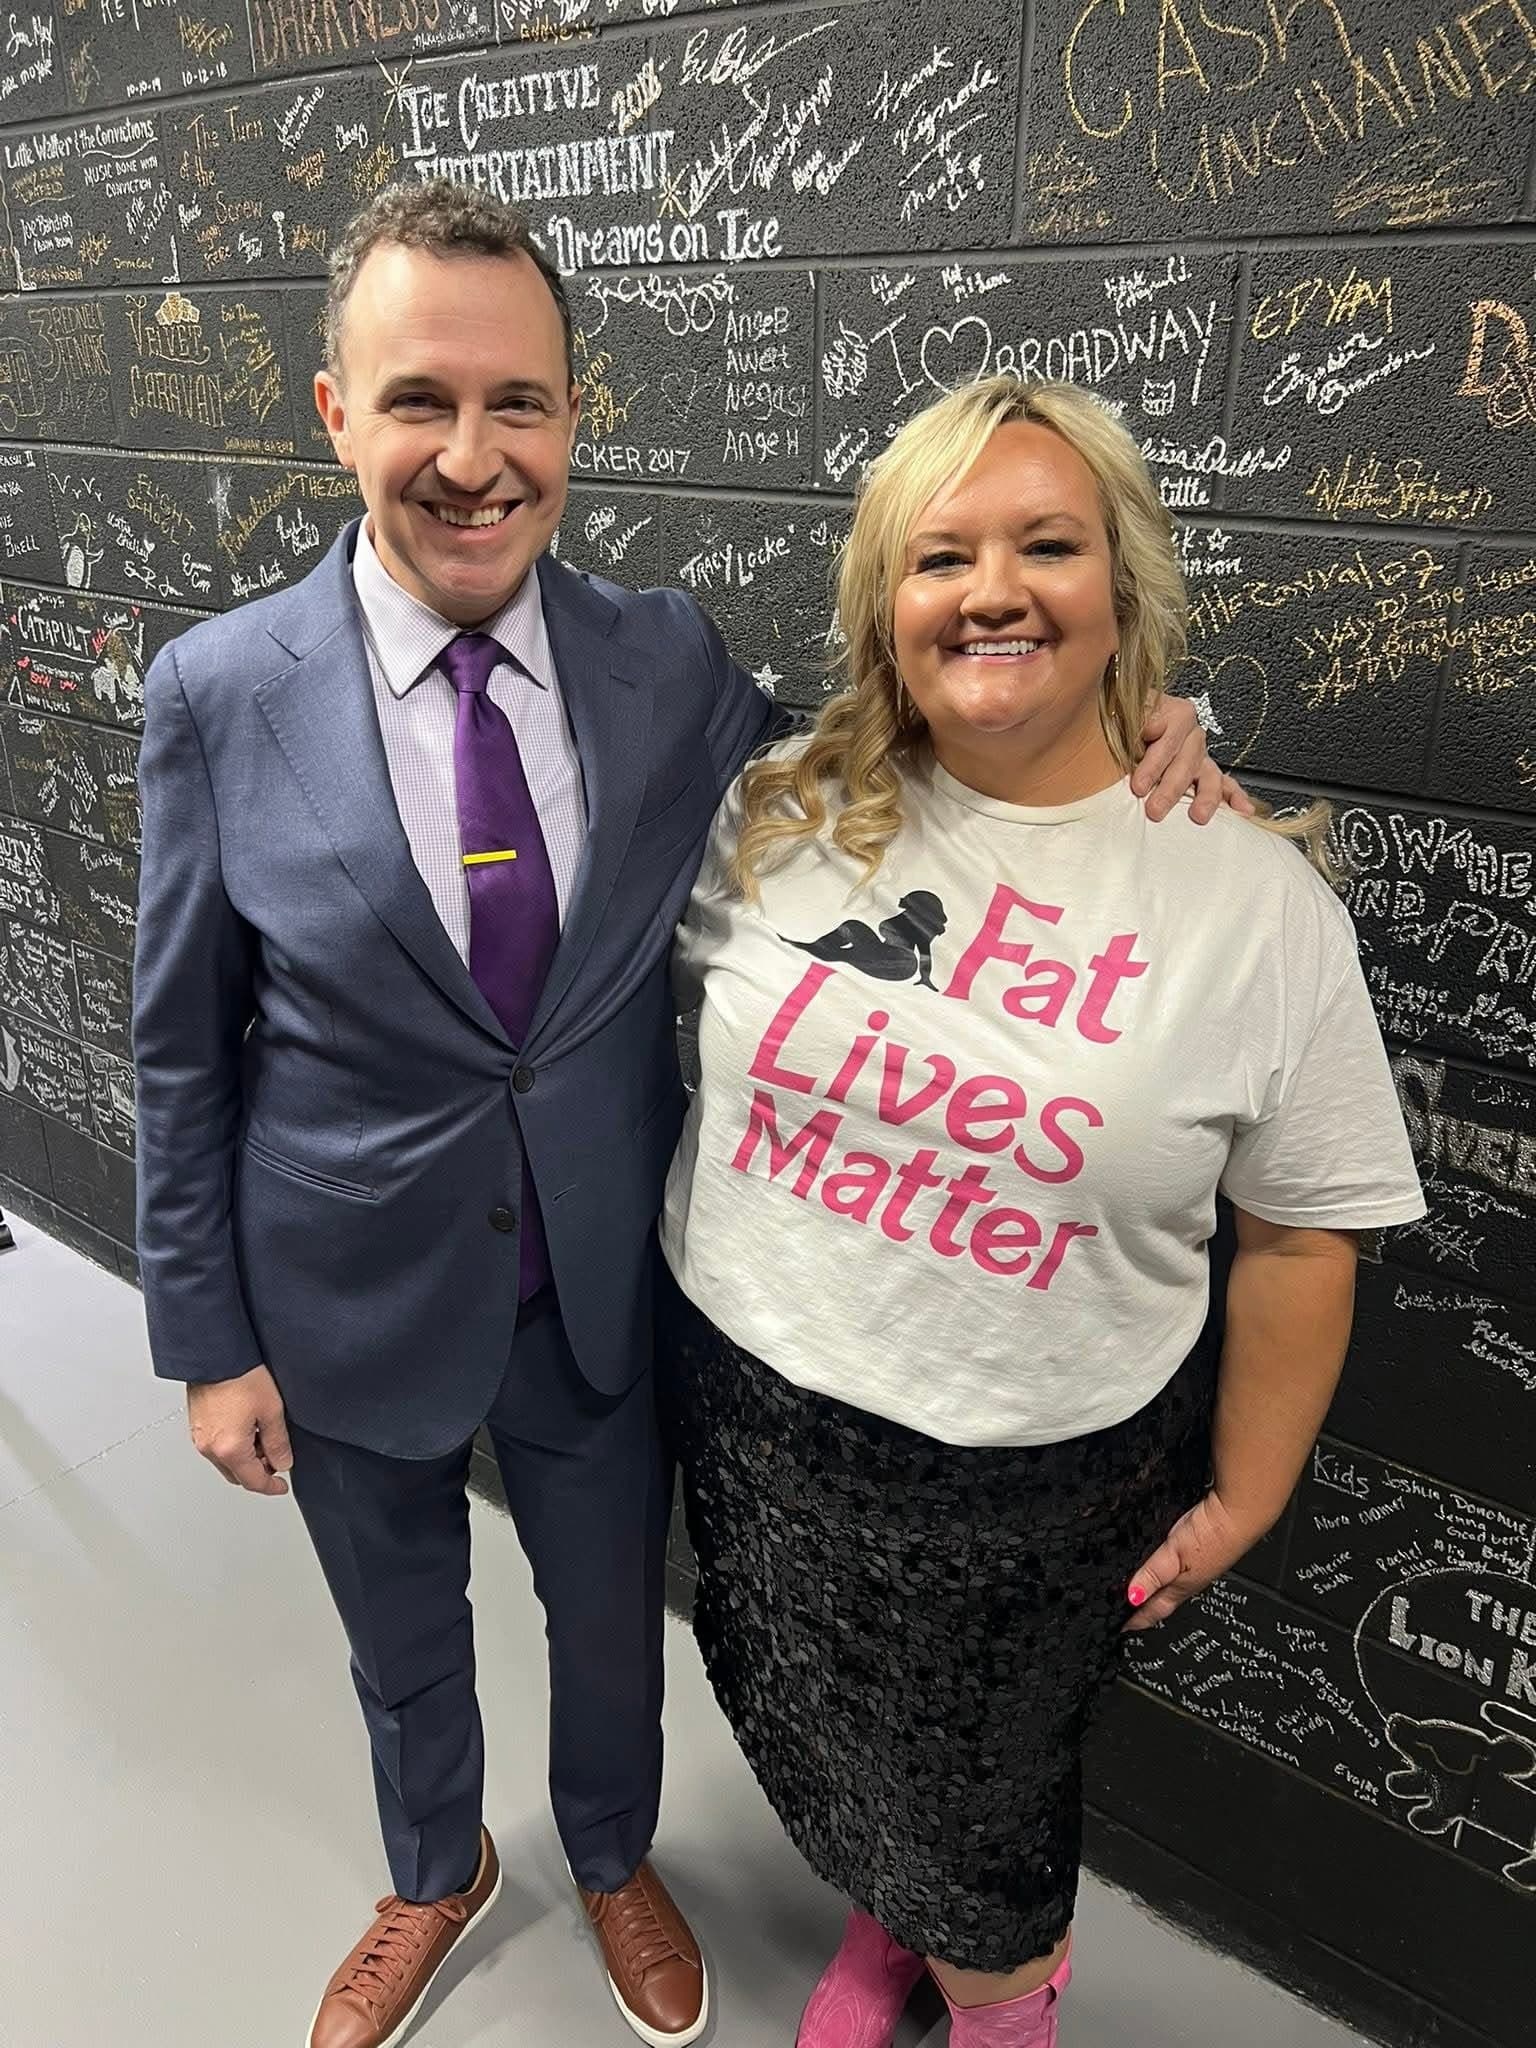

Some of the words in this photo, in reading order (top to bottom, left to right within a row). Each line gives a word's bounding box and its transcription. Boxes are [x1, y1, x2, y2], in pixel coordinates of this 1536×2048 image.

[224, 105, 265, 142] Turn
[458, 63, 600, 151] CREATIVE
[83, 162, 114, 187] MUSIC
[668, 216, 708, 263] on
[716, 207, 782, 262] Ice
[129, 364, 225, 428] CARAVAN
[647, 446, 692, 474] 2017
[18, 604, 92, 657] CATAPULT
[942, 883, 1150, 1045] Fat
[747, 961, 1105, 1184] Lives
[730, 1088, 1099, 1291] Matter
[1313, 1444, 1371, 1496] Kids
[1382, 1469, 1440, 1500] Joshua
[1389, 1595, 1496, 1688] LION
